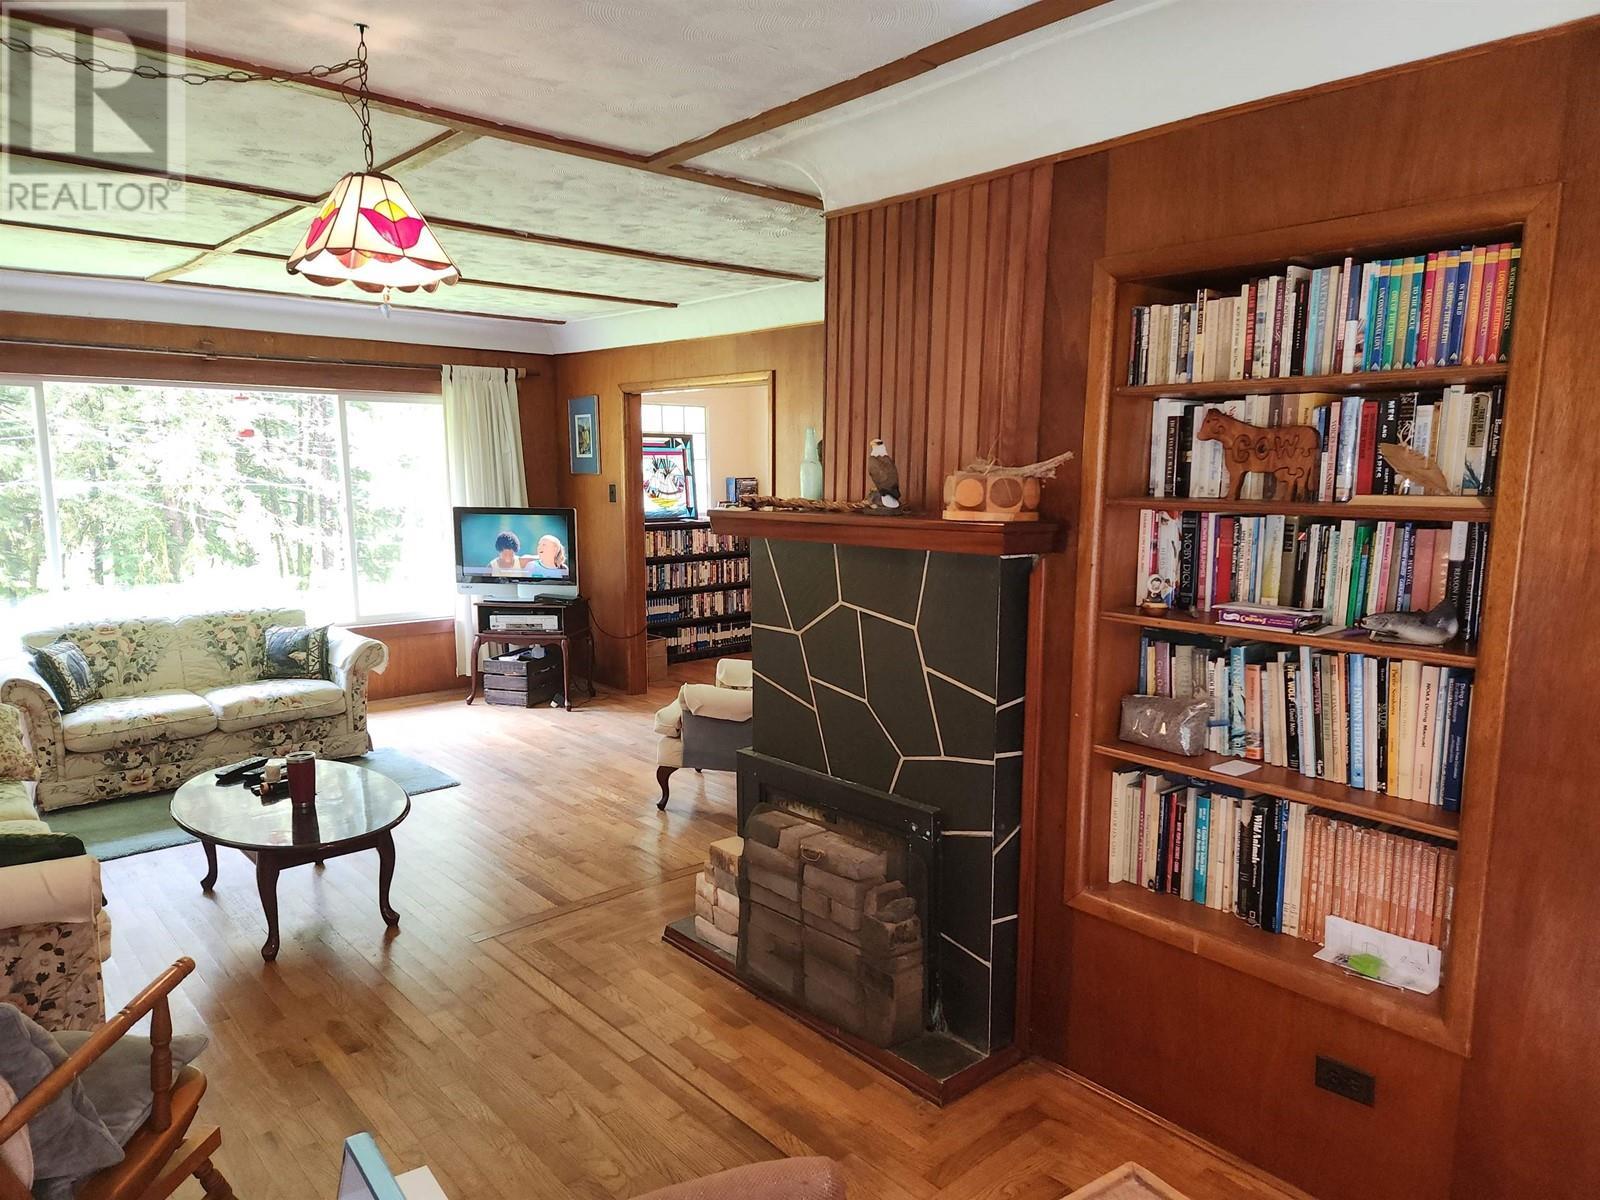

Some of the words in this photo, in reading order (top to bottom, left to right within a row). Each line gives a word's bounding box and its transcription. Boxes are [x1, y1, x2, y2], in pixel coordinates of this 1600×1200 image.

[1497, 270, 1505, 294] LOVING
[1508, 267, 1517, 297] WORKING
[1424, 289, 1433, 314] FAMOUS
[1445, 282, 1454, 309] SHARING
[1376, 288, 1385, 335] UNCONDITIONAL
[1481, 307, 1489, 336] CHANCES
[1492, 308, 1501, 339] CHILDREN
[1504, 299, 1513, 329] PARTNERS
[1422, 314, 1430, 340] ANIMALS
[1441, 324, 1449, 343] EARTH
[1387, 400, 1396, 420] MEN
[1493, 419, 1502, 433] Bear
[1231, 433, 1300, 463] COW
[1490, 434, 1500, 457] Attacks
[1184, 533, 1192, 560] MOBY
[1183, 564, 1191, 587] DICK
[1453, 567, 1461, 593] REASON
[1288, 665, 1296, 678] THE
[1288, 682, 1296, 701] WOLF
[1354, 687, 1362, 721] INDIAN
[1354, 723, 1362, 768] HERITAGE
[1254, 815, 1262, 832] Wild
[1252, 832, 1262, 863] Animals
